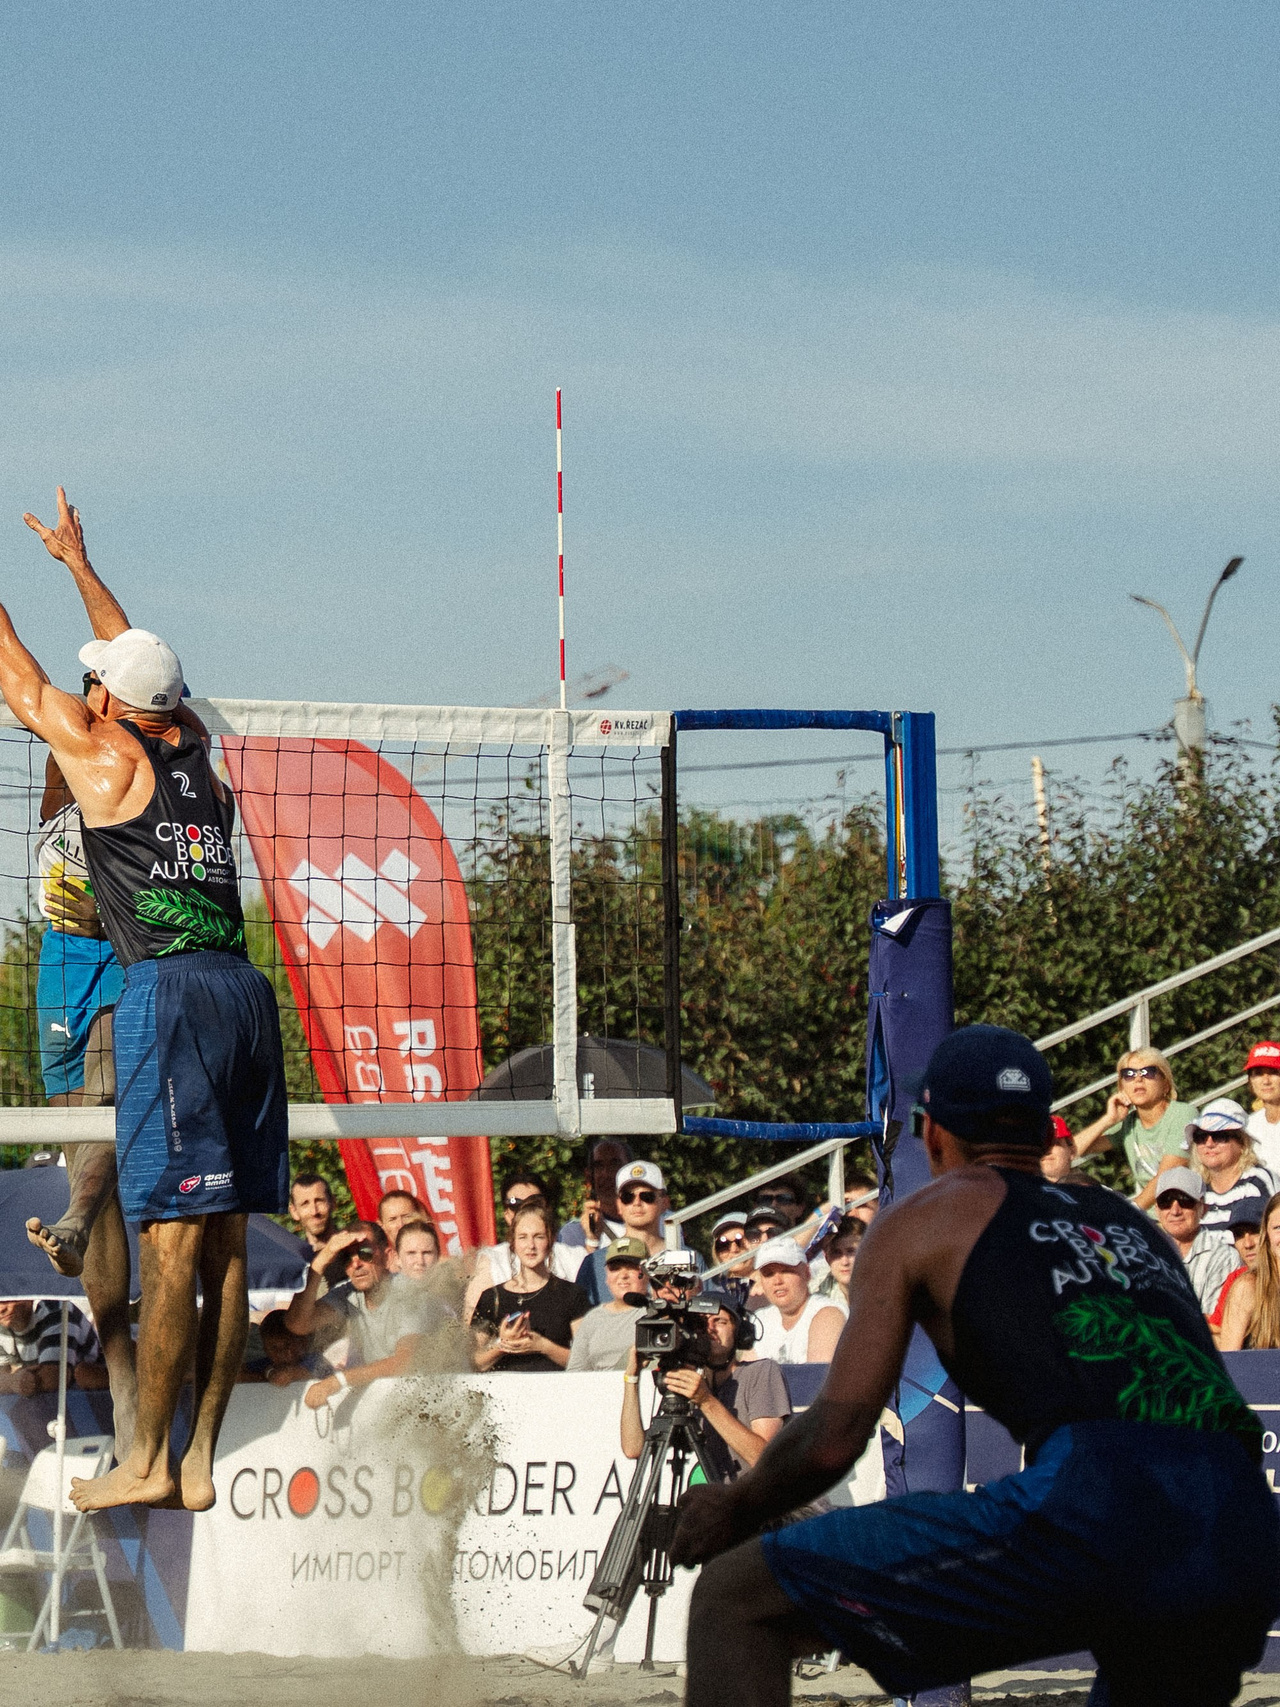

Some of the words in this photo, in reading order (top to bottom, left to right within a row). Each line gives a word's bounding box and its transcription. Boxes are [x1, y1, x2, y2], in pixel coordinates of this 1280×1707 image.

[171, 771, 197, 798] 2
[155, 822, 224, 845] CROSS
[176, 841, 235, 866] BORDE
[149, 860, 206, 881] AUTO
[1029, 1221, 1149, 1250] CROSS
[230, 1465, 373, 1520] CROSS
[392, 1462, 577, 1518] BODER
[291, 1551, 407, 1582] ИМПОРТ
